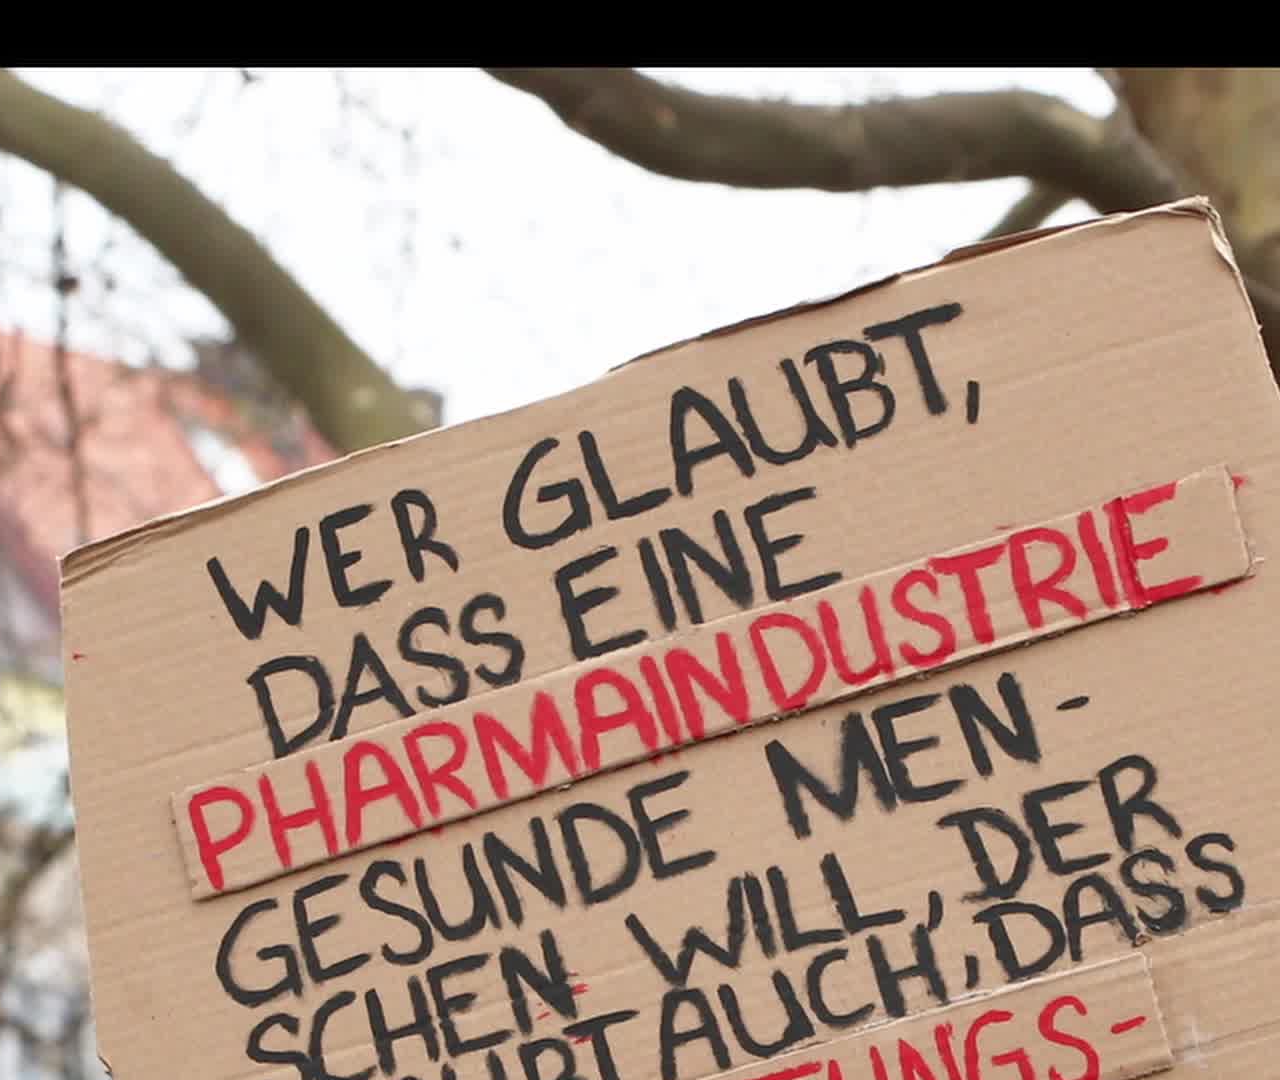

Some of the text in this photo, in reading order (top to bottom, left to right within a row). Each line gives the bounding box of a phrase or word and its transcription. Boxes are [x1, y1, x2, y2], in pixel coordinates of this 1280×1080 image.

[206, 302, 982, 641] WER GLAUBT,
[246, 487, 843, 760] DASS EINE
[186, 480, 1210, 891] PHARMAINDUSTRIE
[215, 671, 1092, 1008] GESUNDE MEN-
[624, 853, 944, 987] WILL,
[936, 753, 1184, 903] DER
